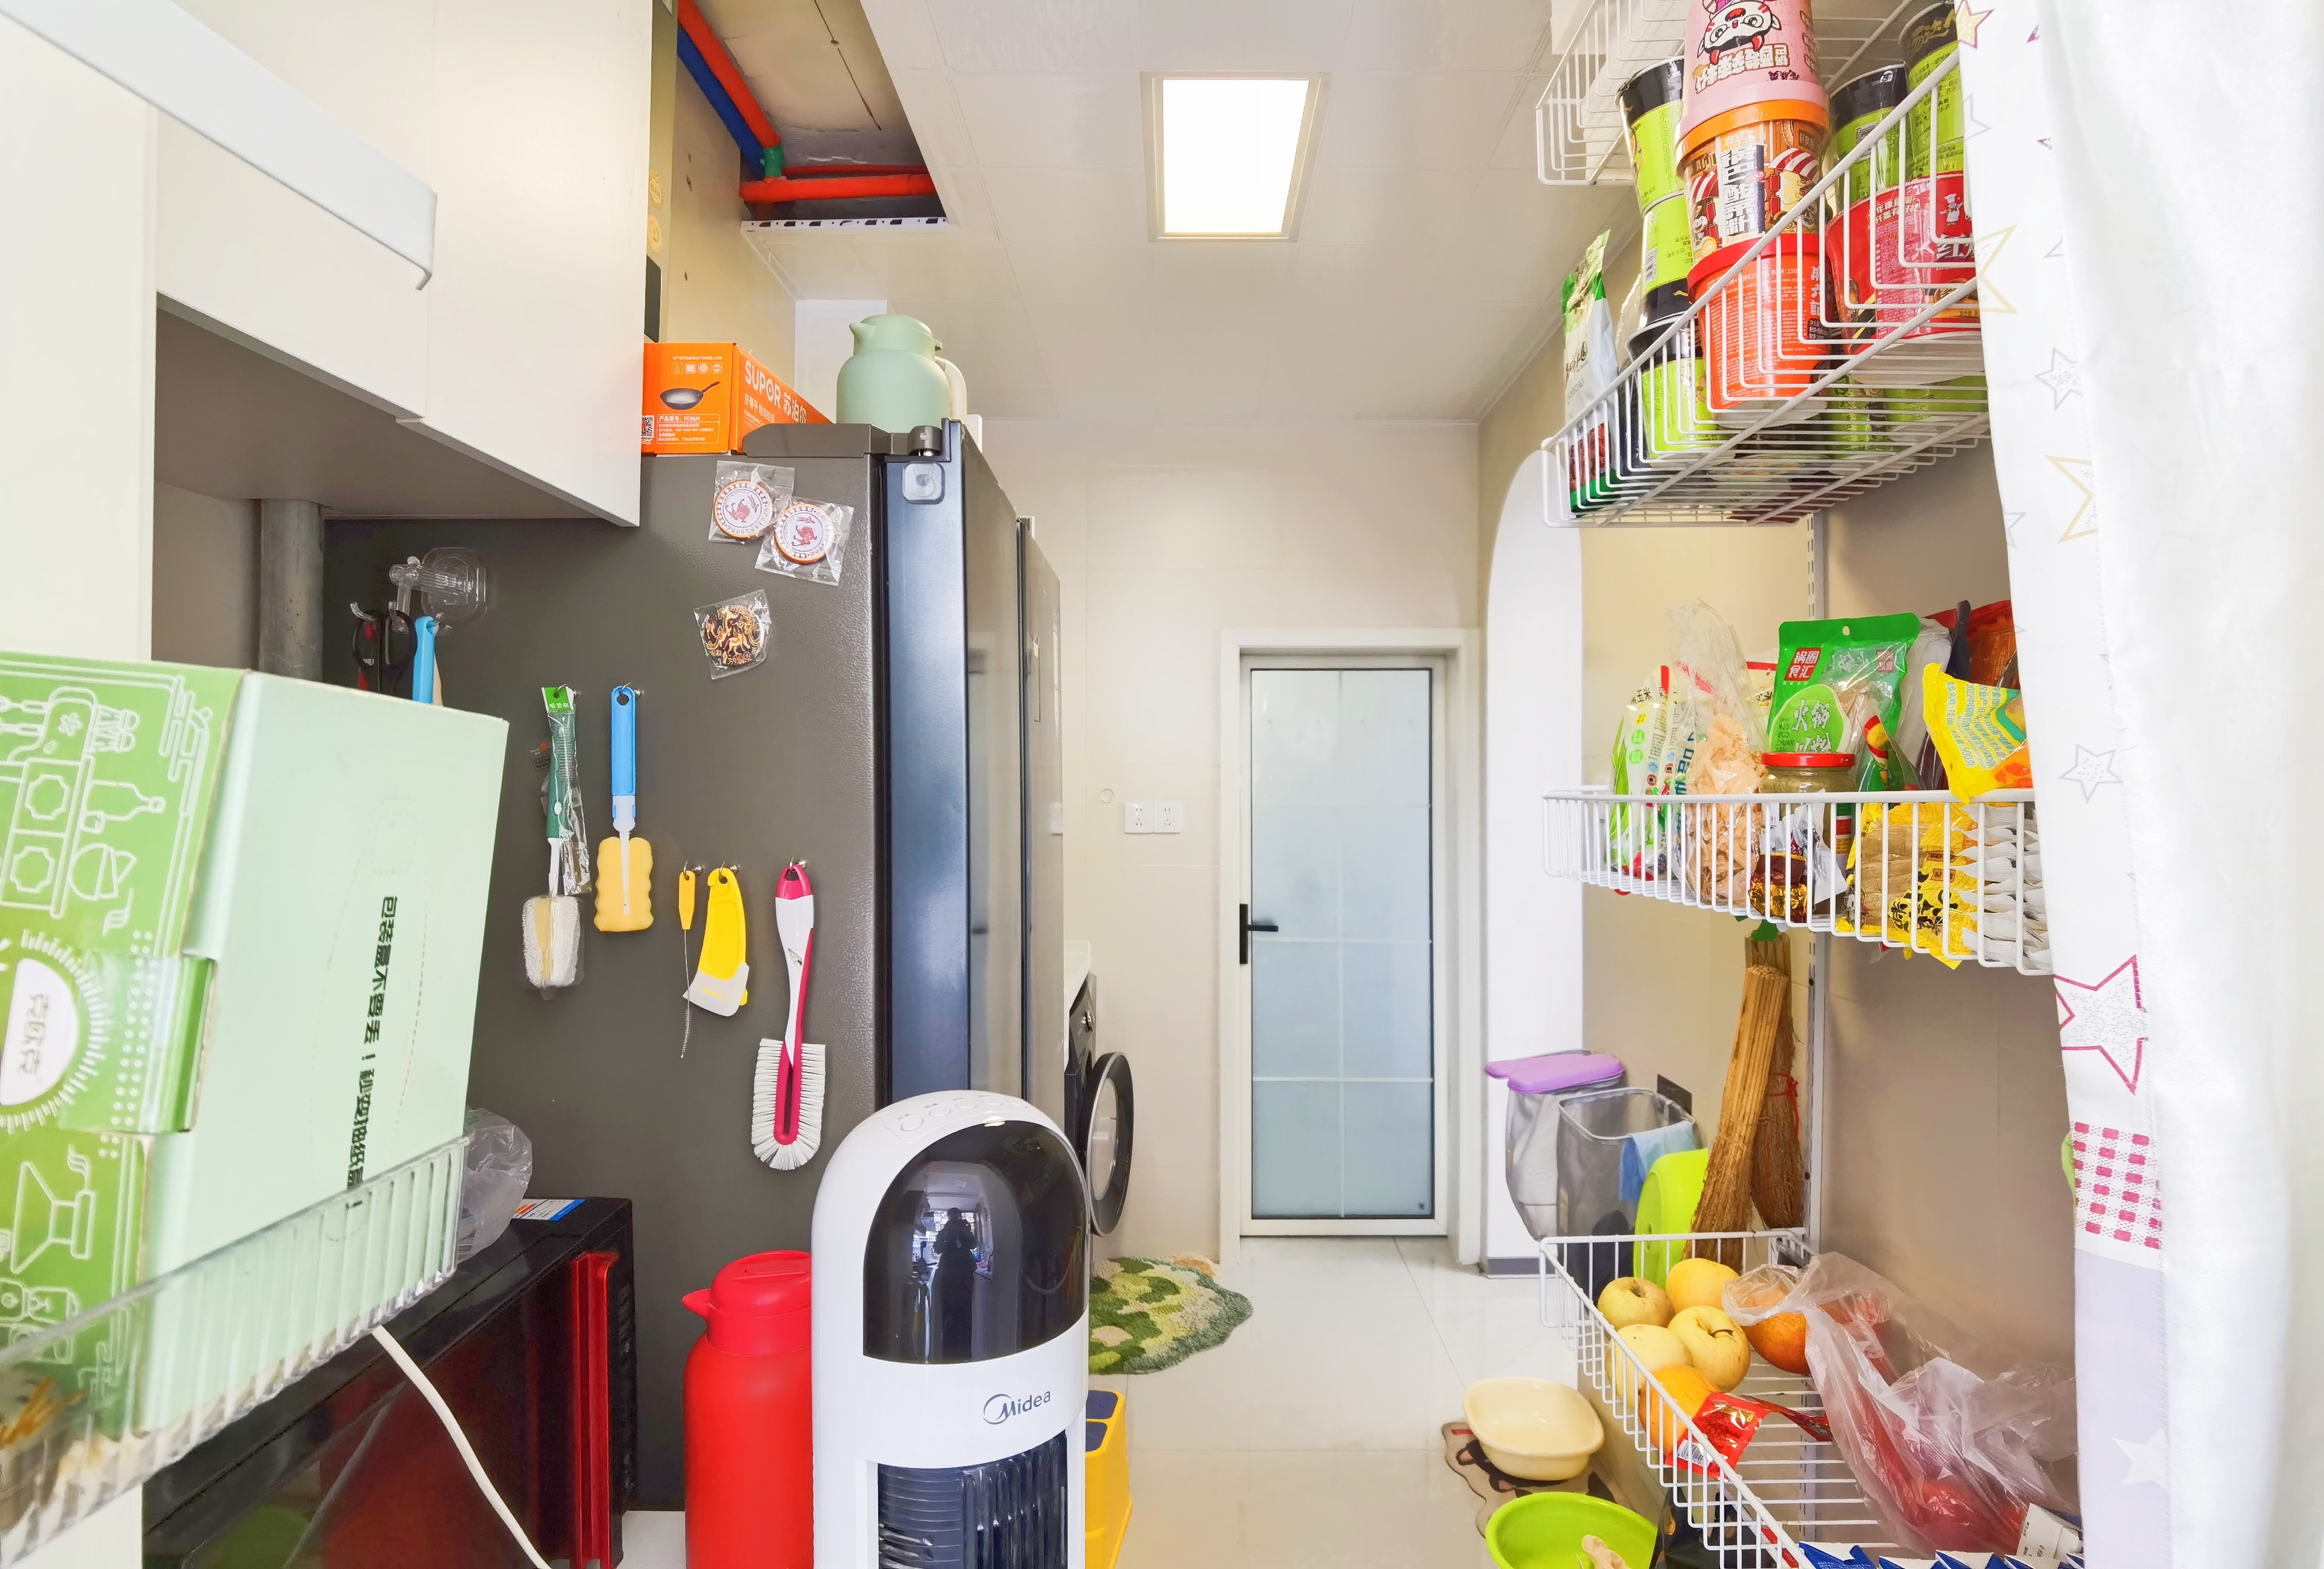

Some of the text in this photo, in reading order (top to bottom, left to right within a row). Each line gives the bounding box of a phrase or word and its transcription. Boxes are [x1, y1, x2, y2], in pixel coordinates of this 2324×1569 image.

[745, 360, 781, 409] SUPOR
[1791, 699, 1830, 732] 火锅
[983, 1391, 1051, 1425] Midea
